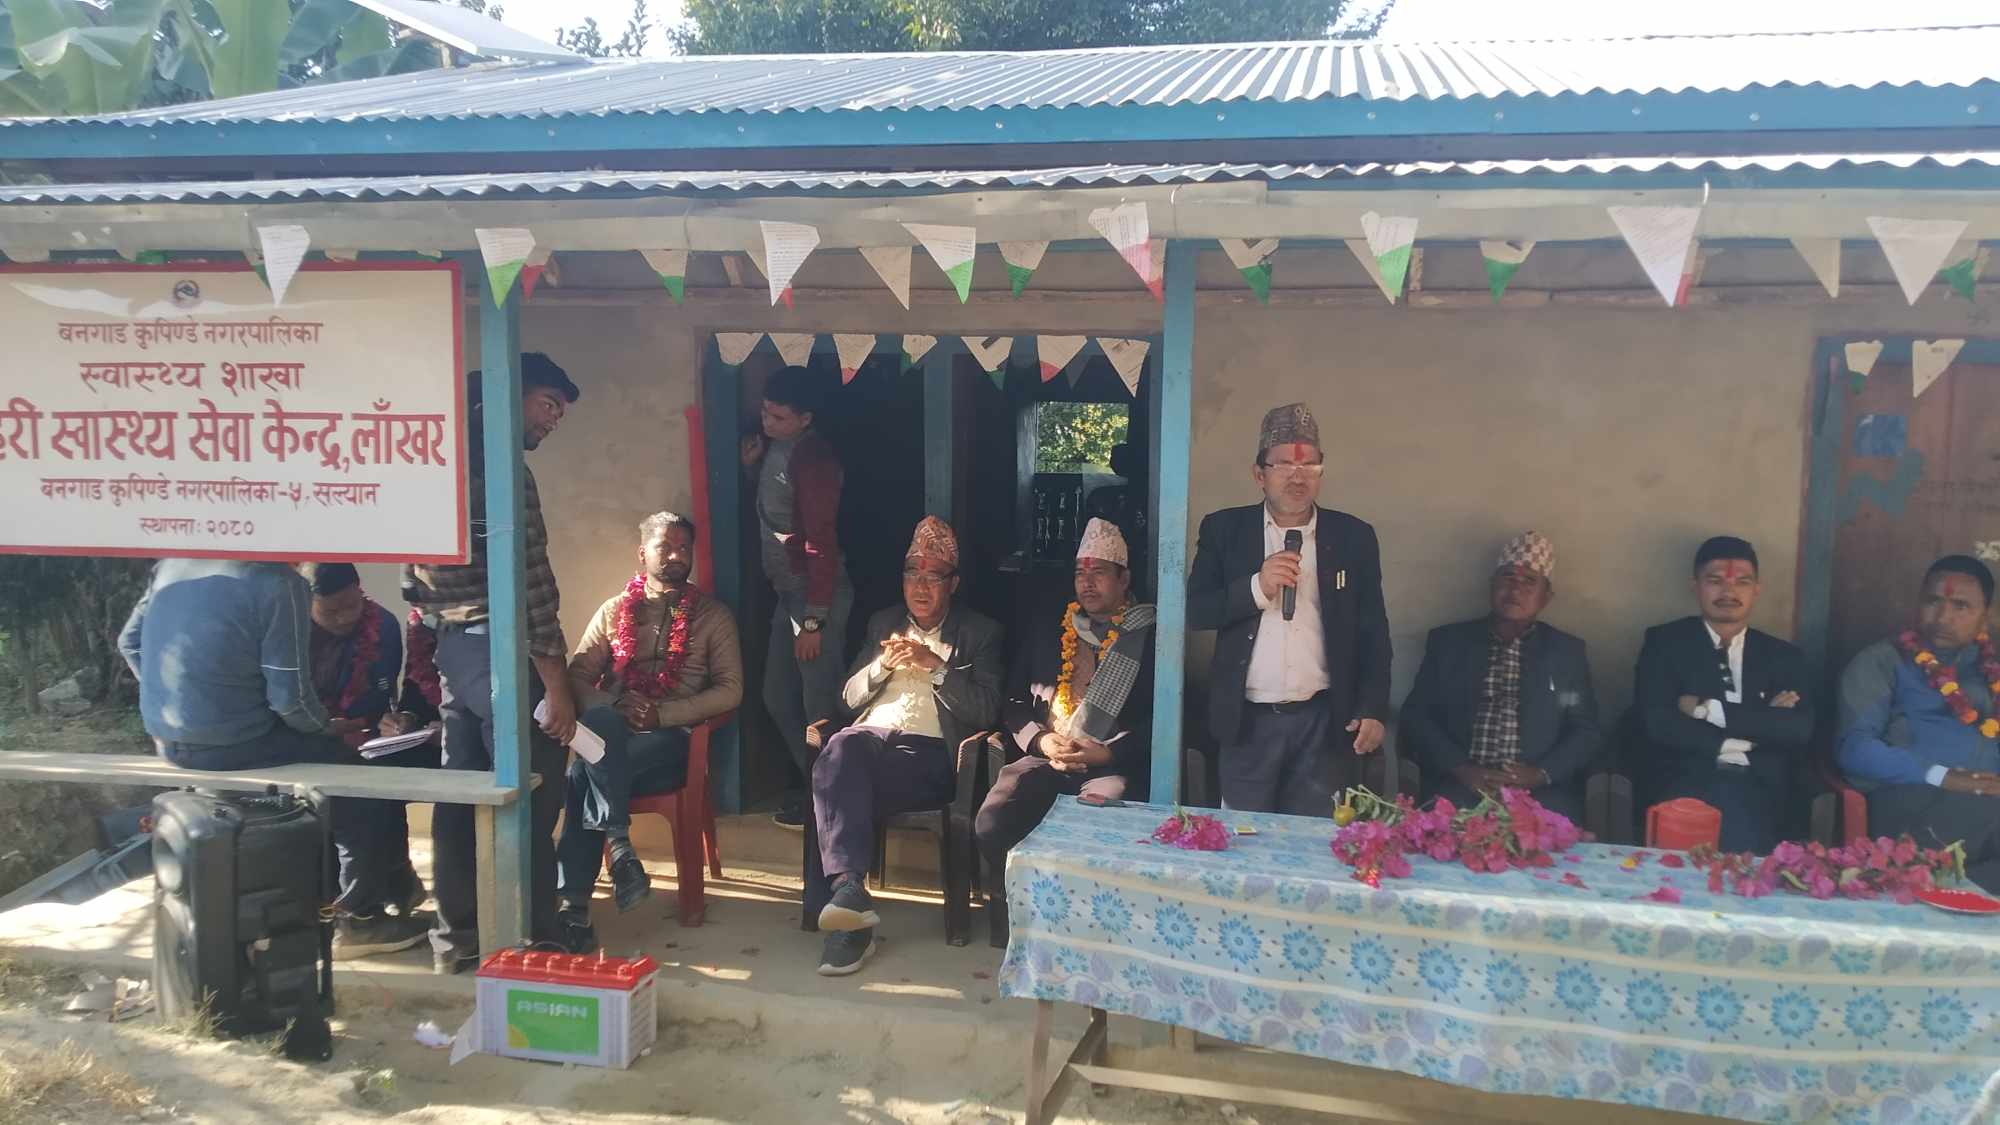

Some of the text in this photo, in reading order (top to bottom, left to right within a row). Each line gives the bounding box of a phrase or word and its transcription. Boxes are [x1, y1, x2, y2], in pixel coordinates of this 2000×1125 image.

[58, 315, 323, 349] बनगाड कुपिण्डे नगरपालिका
[79, 362, 305, 396] स्वास्थ्य शाखा
[0, 397, 44, 460] री
[51, 410, 178, 461] स्वास्थ्य
[188, 398, 255, 462] सेवा
[40, 477, 104, 501] बनगाड
[109, 472, 171, 507] कुपिण्डे
[312, 481, 381, 507] सल्यान
[207, 519, 255, 538] २०८०
[516, 999, 588, 1019] ASIAN
